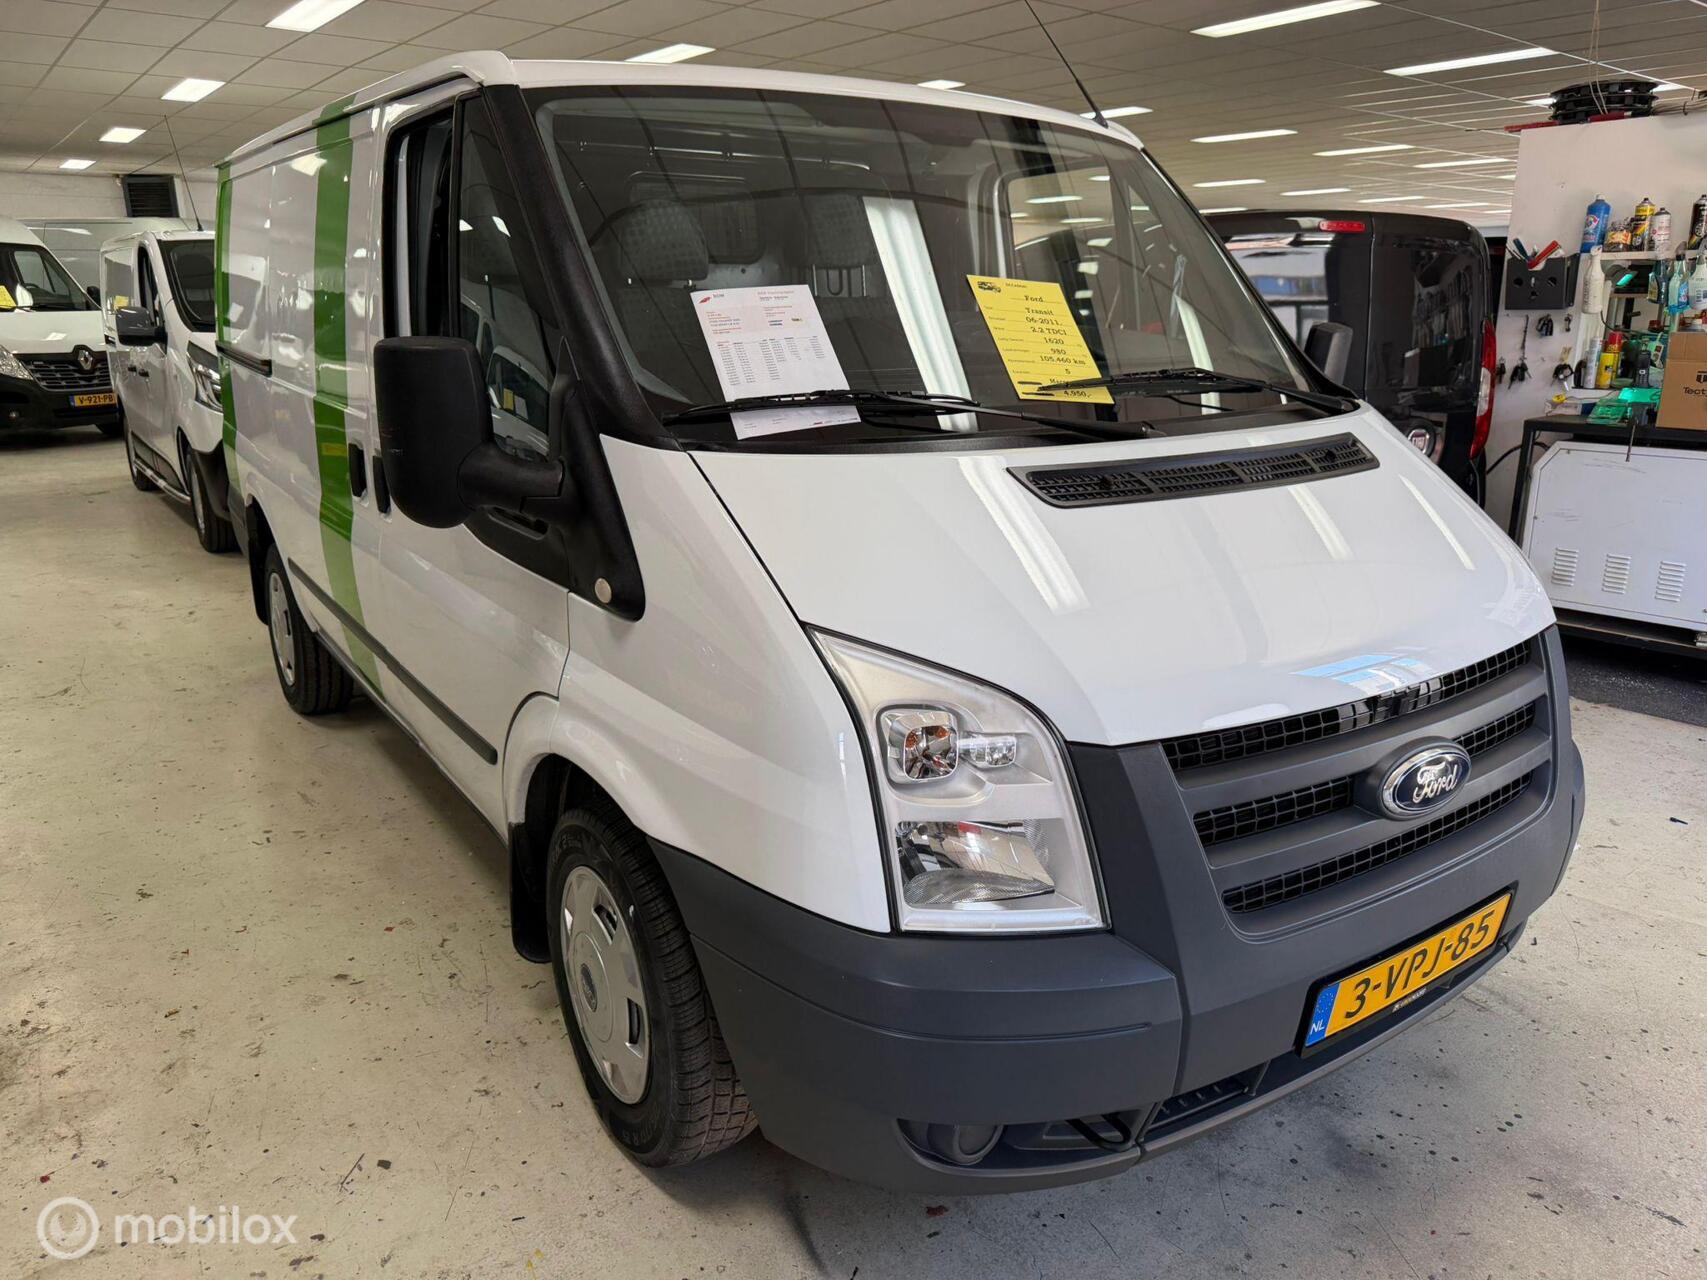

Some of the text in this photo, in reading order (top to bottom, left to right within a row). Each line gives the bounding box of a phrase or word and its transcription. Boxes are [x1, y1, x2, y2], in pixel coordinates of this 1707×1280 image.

[1025, 295, 1043, 303] Ford
[1025, 307, 1054, 315] Transit
[1044, 336, 1064, 345] 1620
[78, 394, 114, 405] V-921-PB
[1412, 761, 1458, 804] Ford
[1310, 1018, 1326, 1035] NL
[1344, 909, 1495, 1019] 3-VPJ-85
